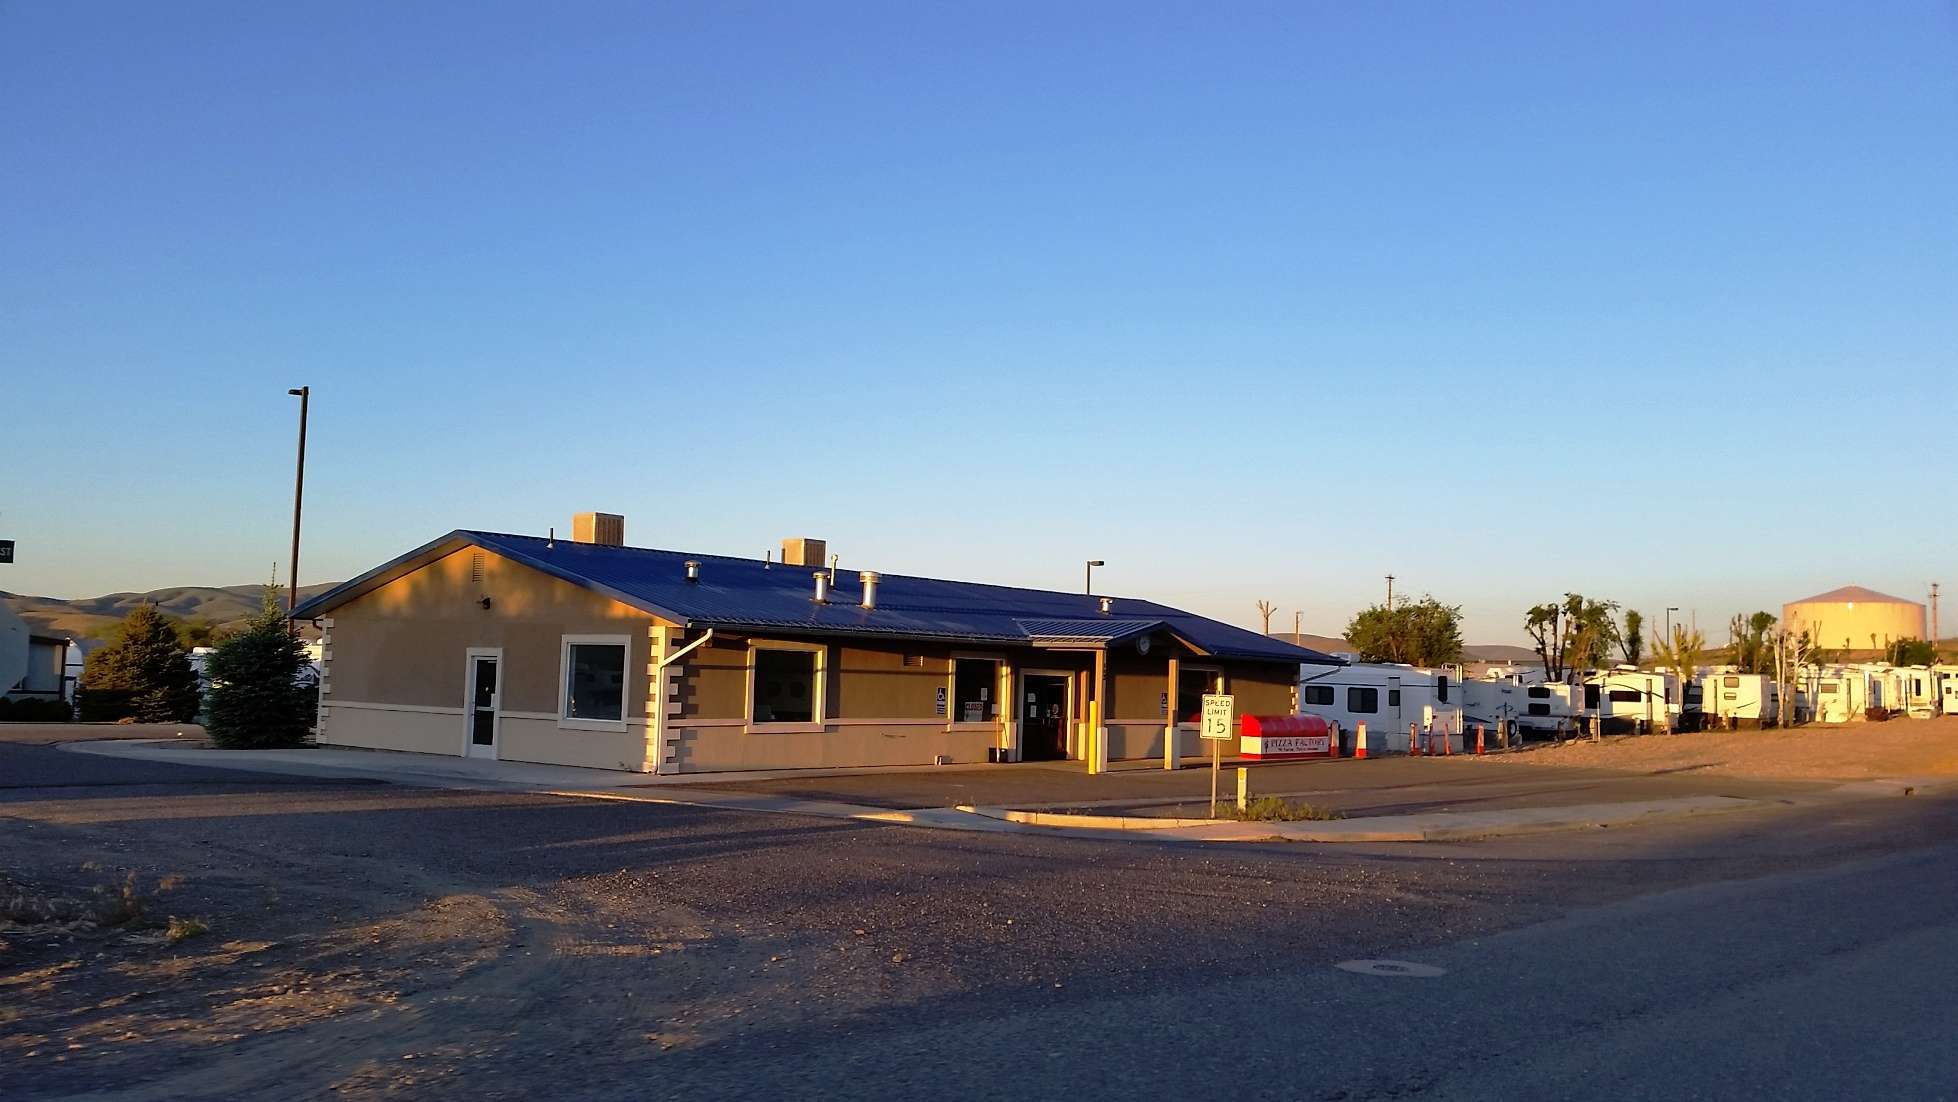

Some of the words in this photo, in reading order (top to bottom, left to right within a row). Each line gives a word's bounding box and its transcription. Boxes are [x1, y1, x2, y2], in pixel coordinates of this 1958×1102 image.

[1205, 699, 1231, 707] SPEED
[1208, 718, 1226, 734] 15
[1271, 738, 1293, 747] PIZZA
